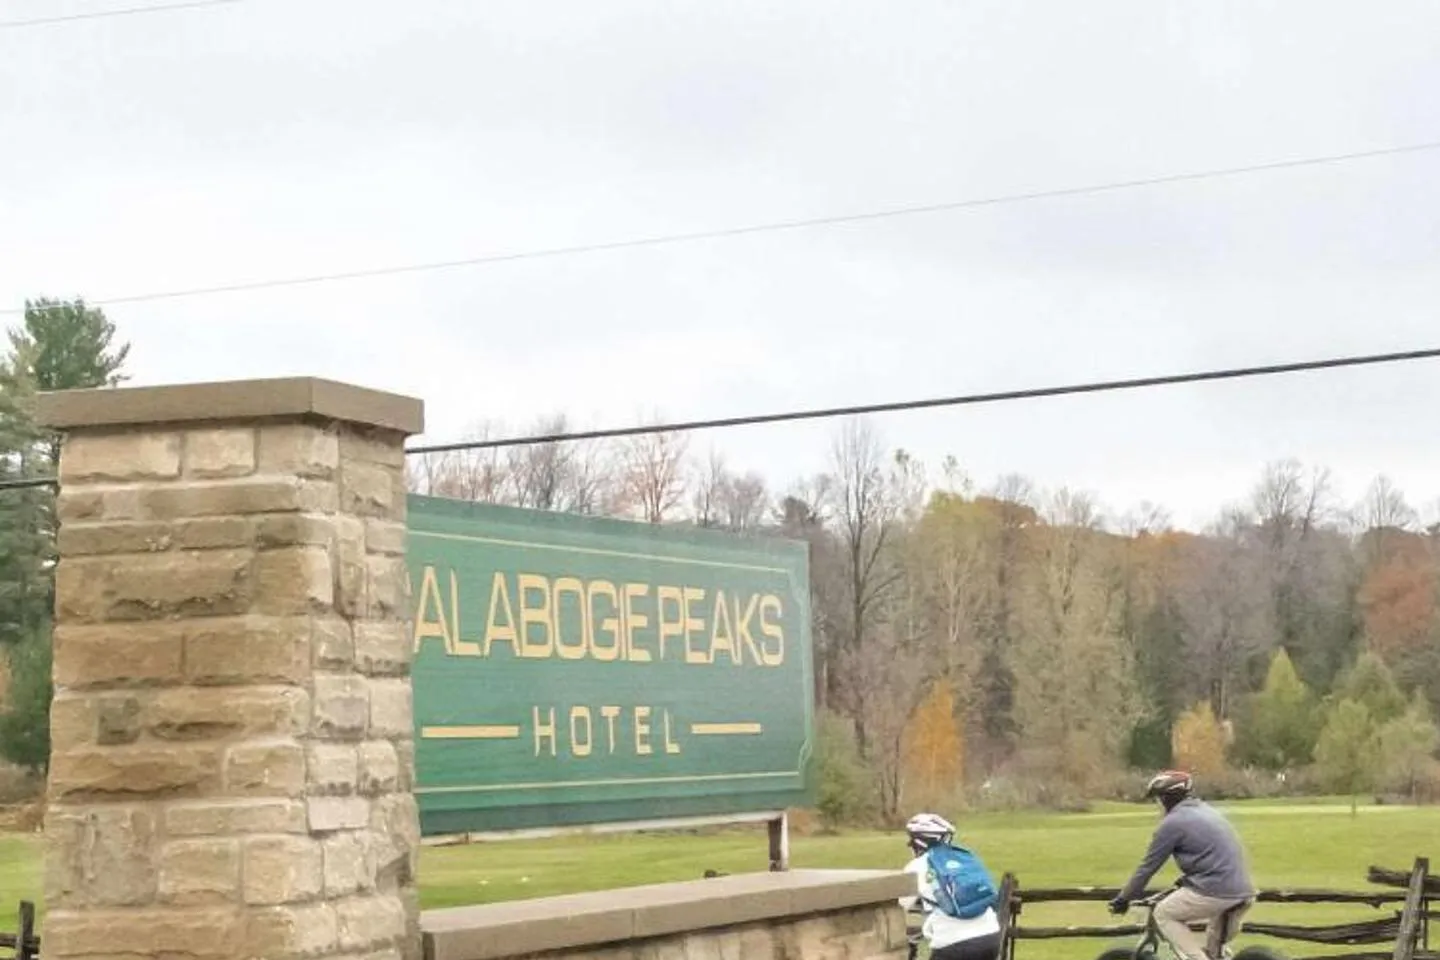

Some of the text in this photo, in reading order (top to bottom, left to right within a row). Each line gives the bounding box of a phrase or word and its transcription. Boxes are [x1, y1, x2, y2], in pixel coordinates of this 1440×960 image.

[406, 565, 785, 667] ALABOGIE PEAKS
[532, 705, 681, 758] HOTEL
